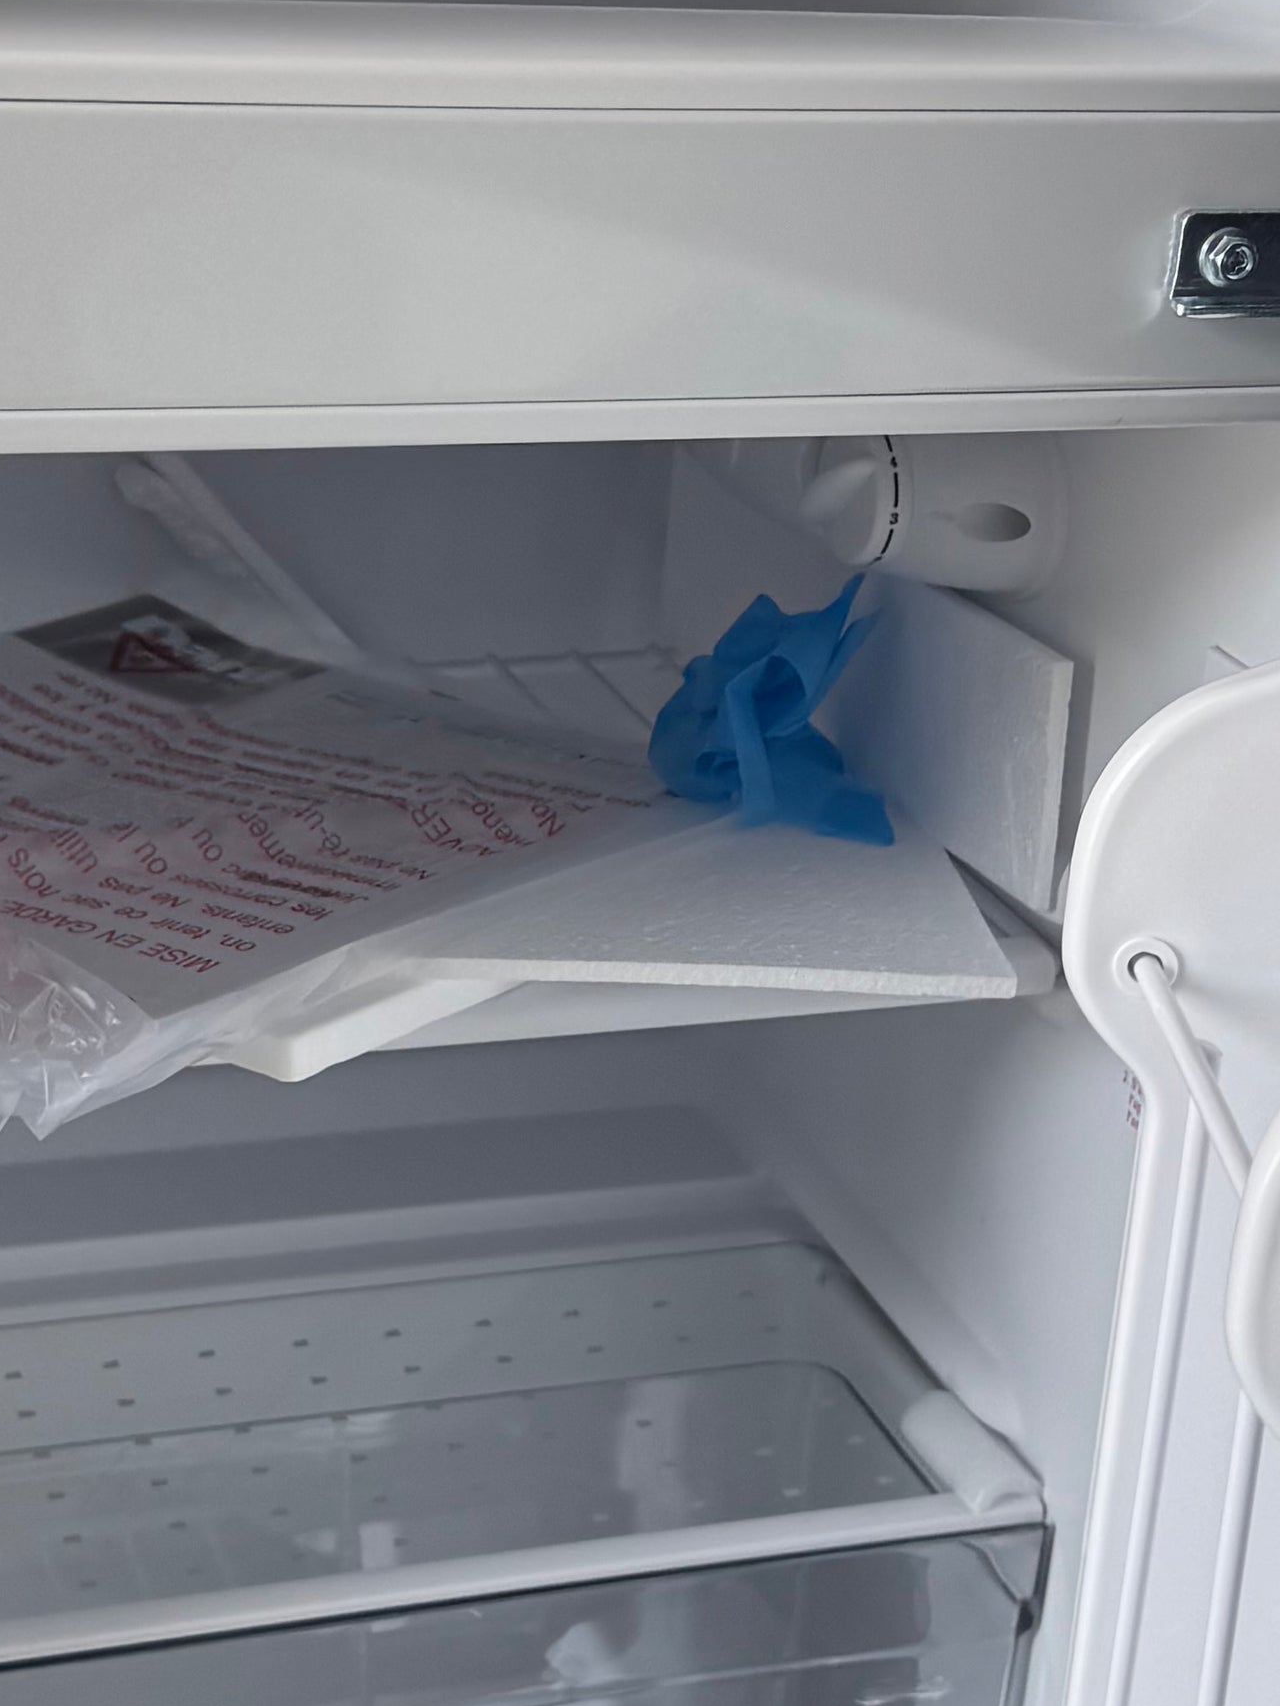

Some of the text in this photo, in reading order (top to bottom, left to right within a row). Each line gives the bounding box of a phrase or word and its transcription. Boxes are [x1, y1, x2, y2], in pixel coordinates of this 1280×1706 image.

[889, 512, 899, 525] 3
[93, 928, 144, 949] EN
[138, 942, 219, 972] MISE
